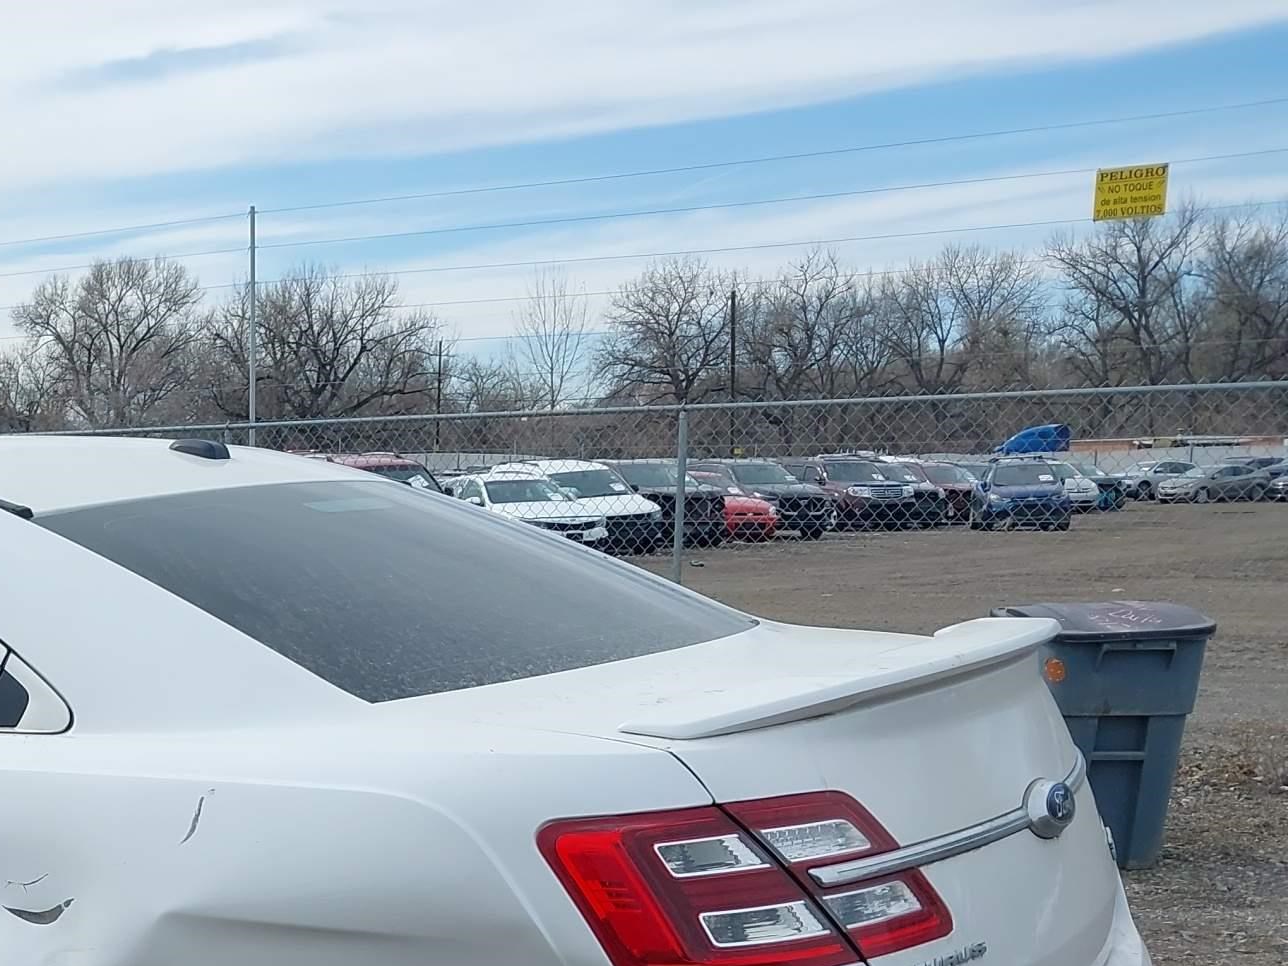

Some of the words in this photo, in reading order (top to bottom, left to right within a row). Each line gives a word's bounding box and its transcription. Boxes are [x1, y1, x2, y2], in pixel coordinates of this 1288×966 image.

[1100, 167, 1166, 182] PELIGRO
[1108, 184, 1121, 194] NO
[1124, 181, 1154, 193] TOQUE
[1120, 204, 1162, 216] VOLTIOS
